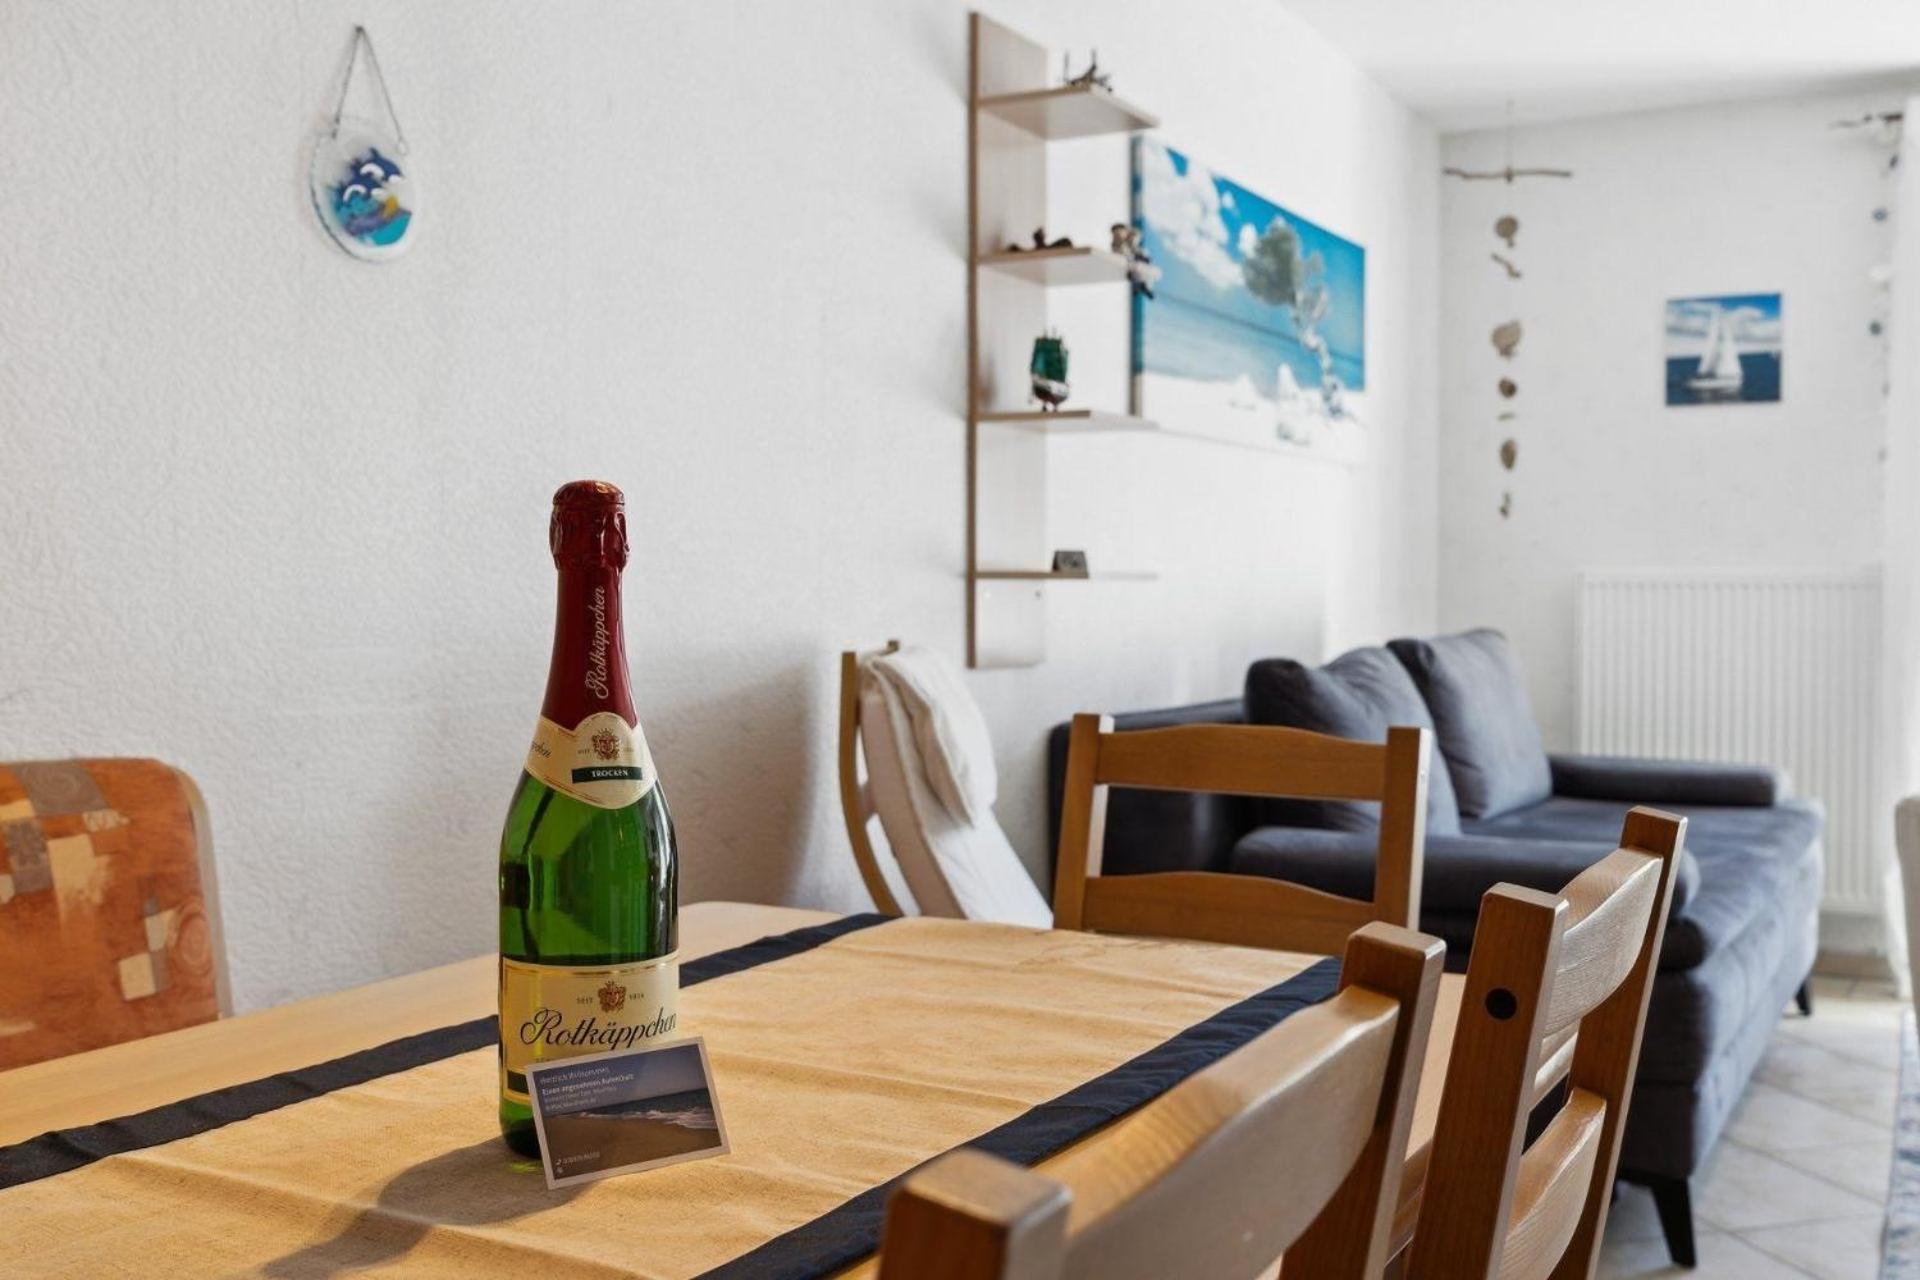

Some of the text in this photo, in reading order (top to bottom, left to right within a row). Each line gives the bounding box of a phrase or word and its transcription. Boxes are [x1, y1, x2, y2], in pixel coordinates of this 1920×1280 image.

[585, 585, 611, 700] Rotkäppchen
[591, 769, 629, 778] TROCKEN
[520, 1006, 677, 1051] Rotkäppchen
